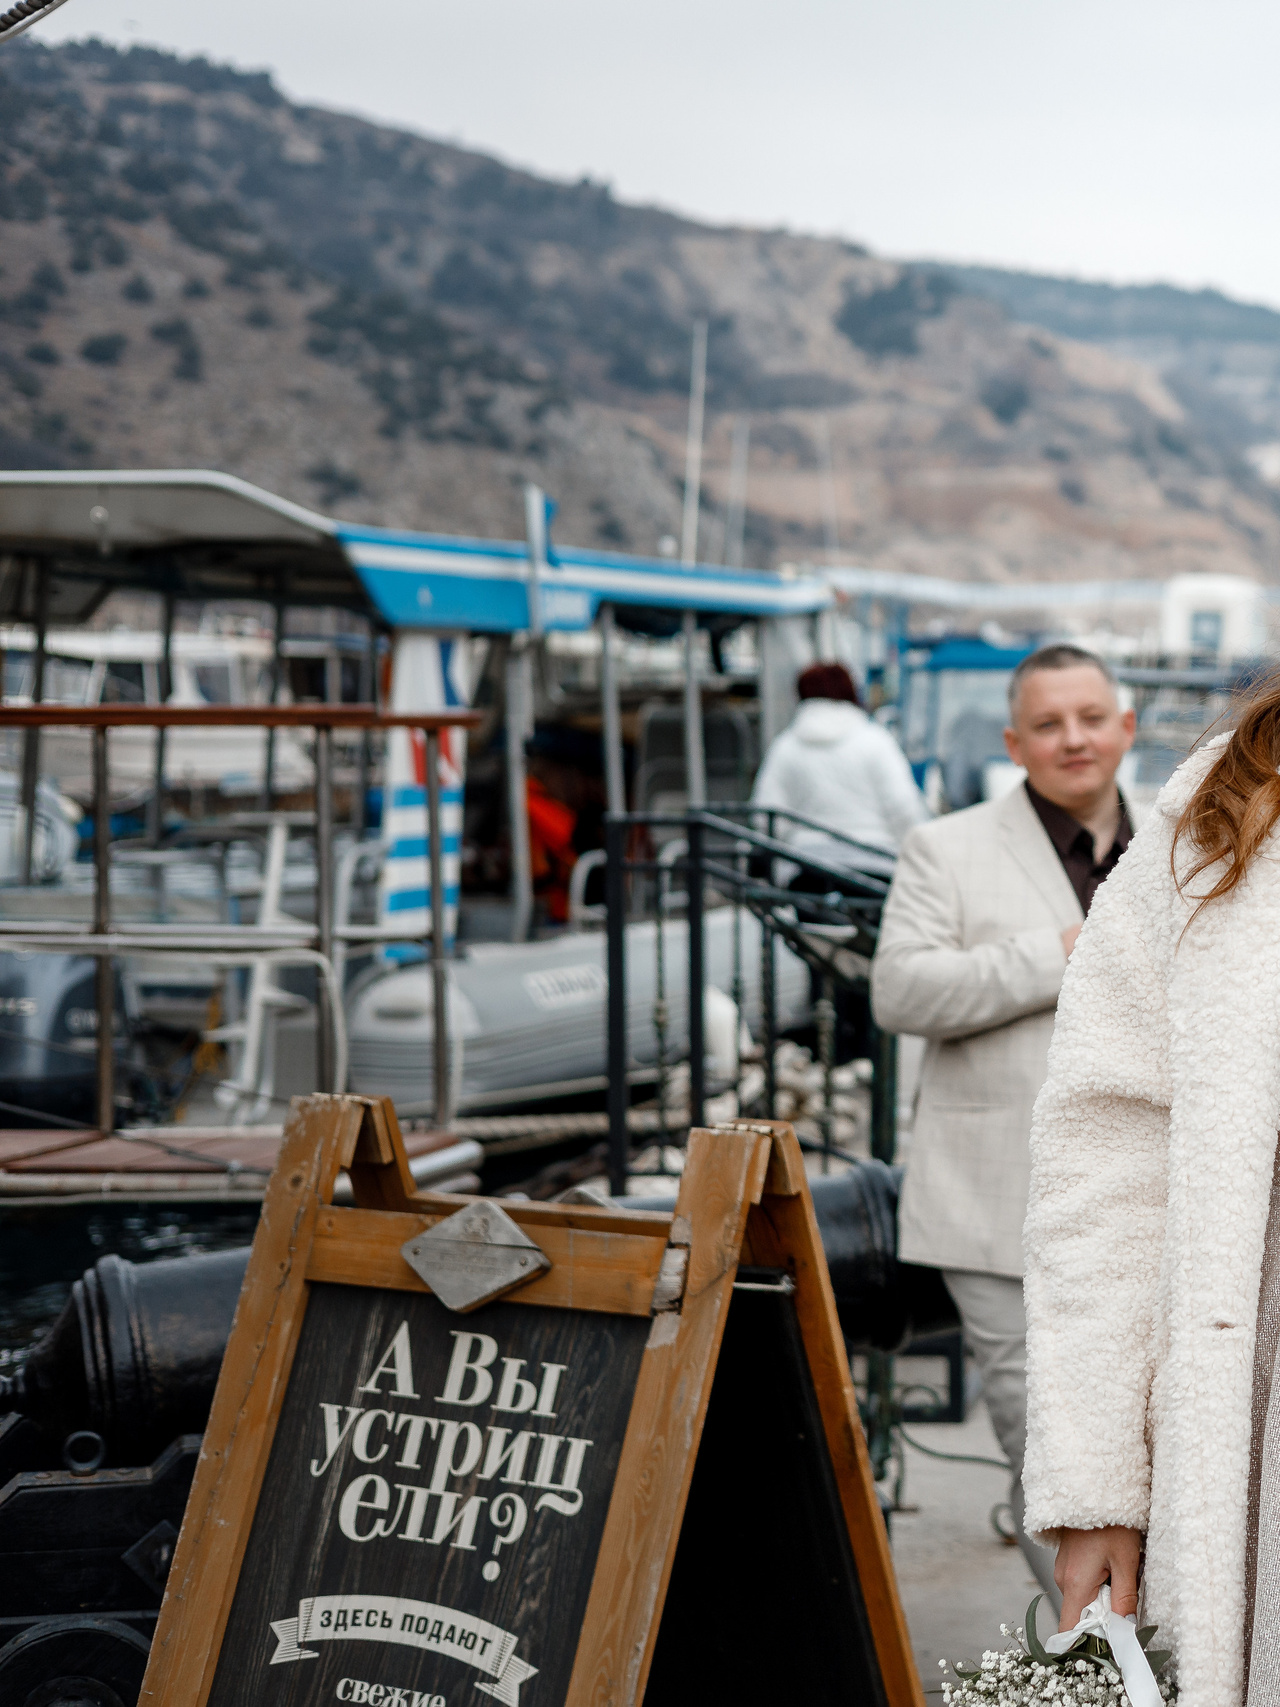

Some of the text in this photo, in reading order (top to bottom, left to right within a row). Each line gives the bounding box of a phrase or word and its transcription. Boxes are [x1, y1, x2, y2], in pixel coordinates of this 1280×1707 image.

[356, 1320, 568, 1418] А Вы
[310, 1402, 594, 1516] устриц
[338, 1473, 528, 1582] ели?
[319, 1608, 492, 1656] ЗДЕСЬ ПОДАЮТ
